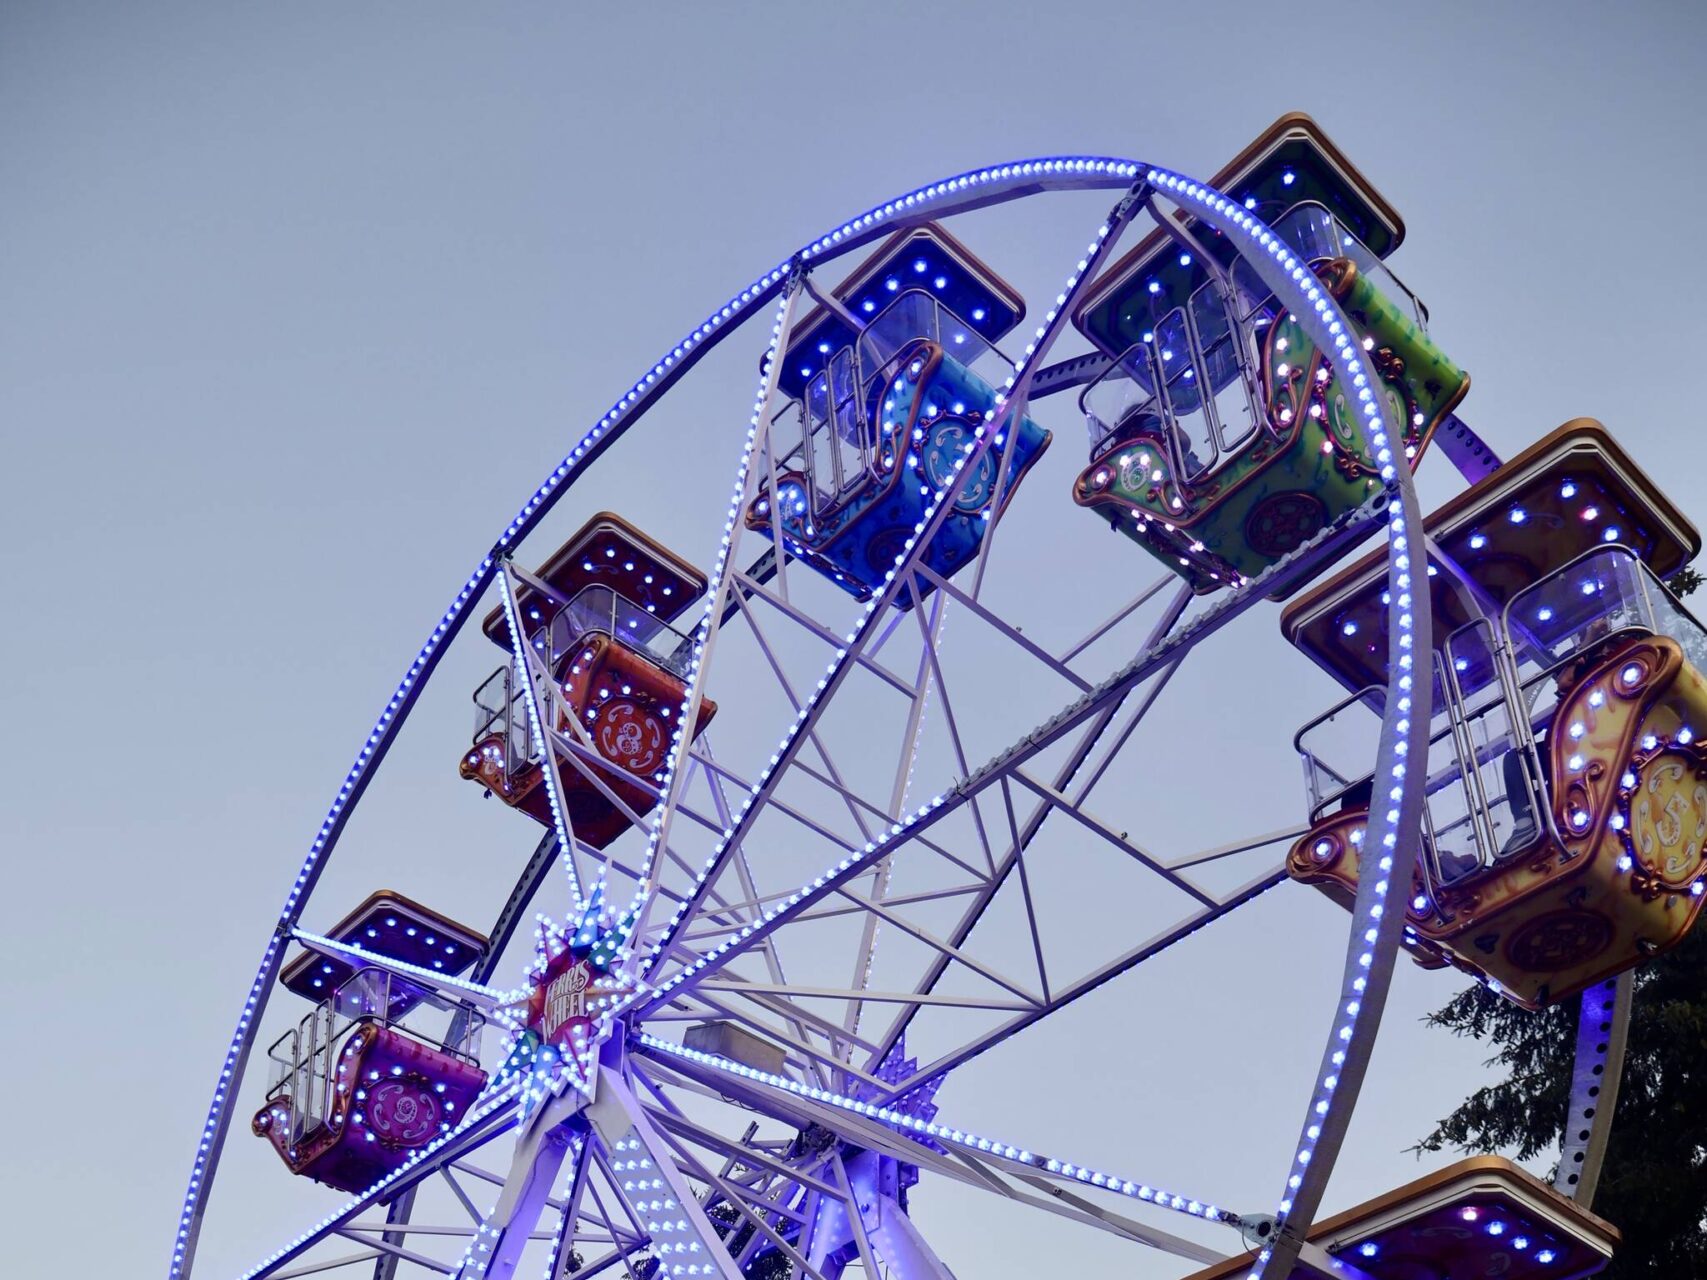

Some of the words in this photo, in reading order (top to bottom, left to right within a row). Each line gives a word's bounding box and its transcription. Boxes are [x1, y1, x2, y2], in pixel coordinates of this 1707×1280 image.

[616, 722, 642, 754] 8
[1655, 791, 1690, 846] 5
[547, 959, 590, 1003] FERRIS
[542, 990, 589, 1045] WHEEL
[393, 1096, 418, 1124] 9
